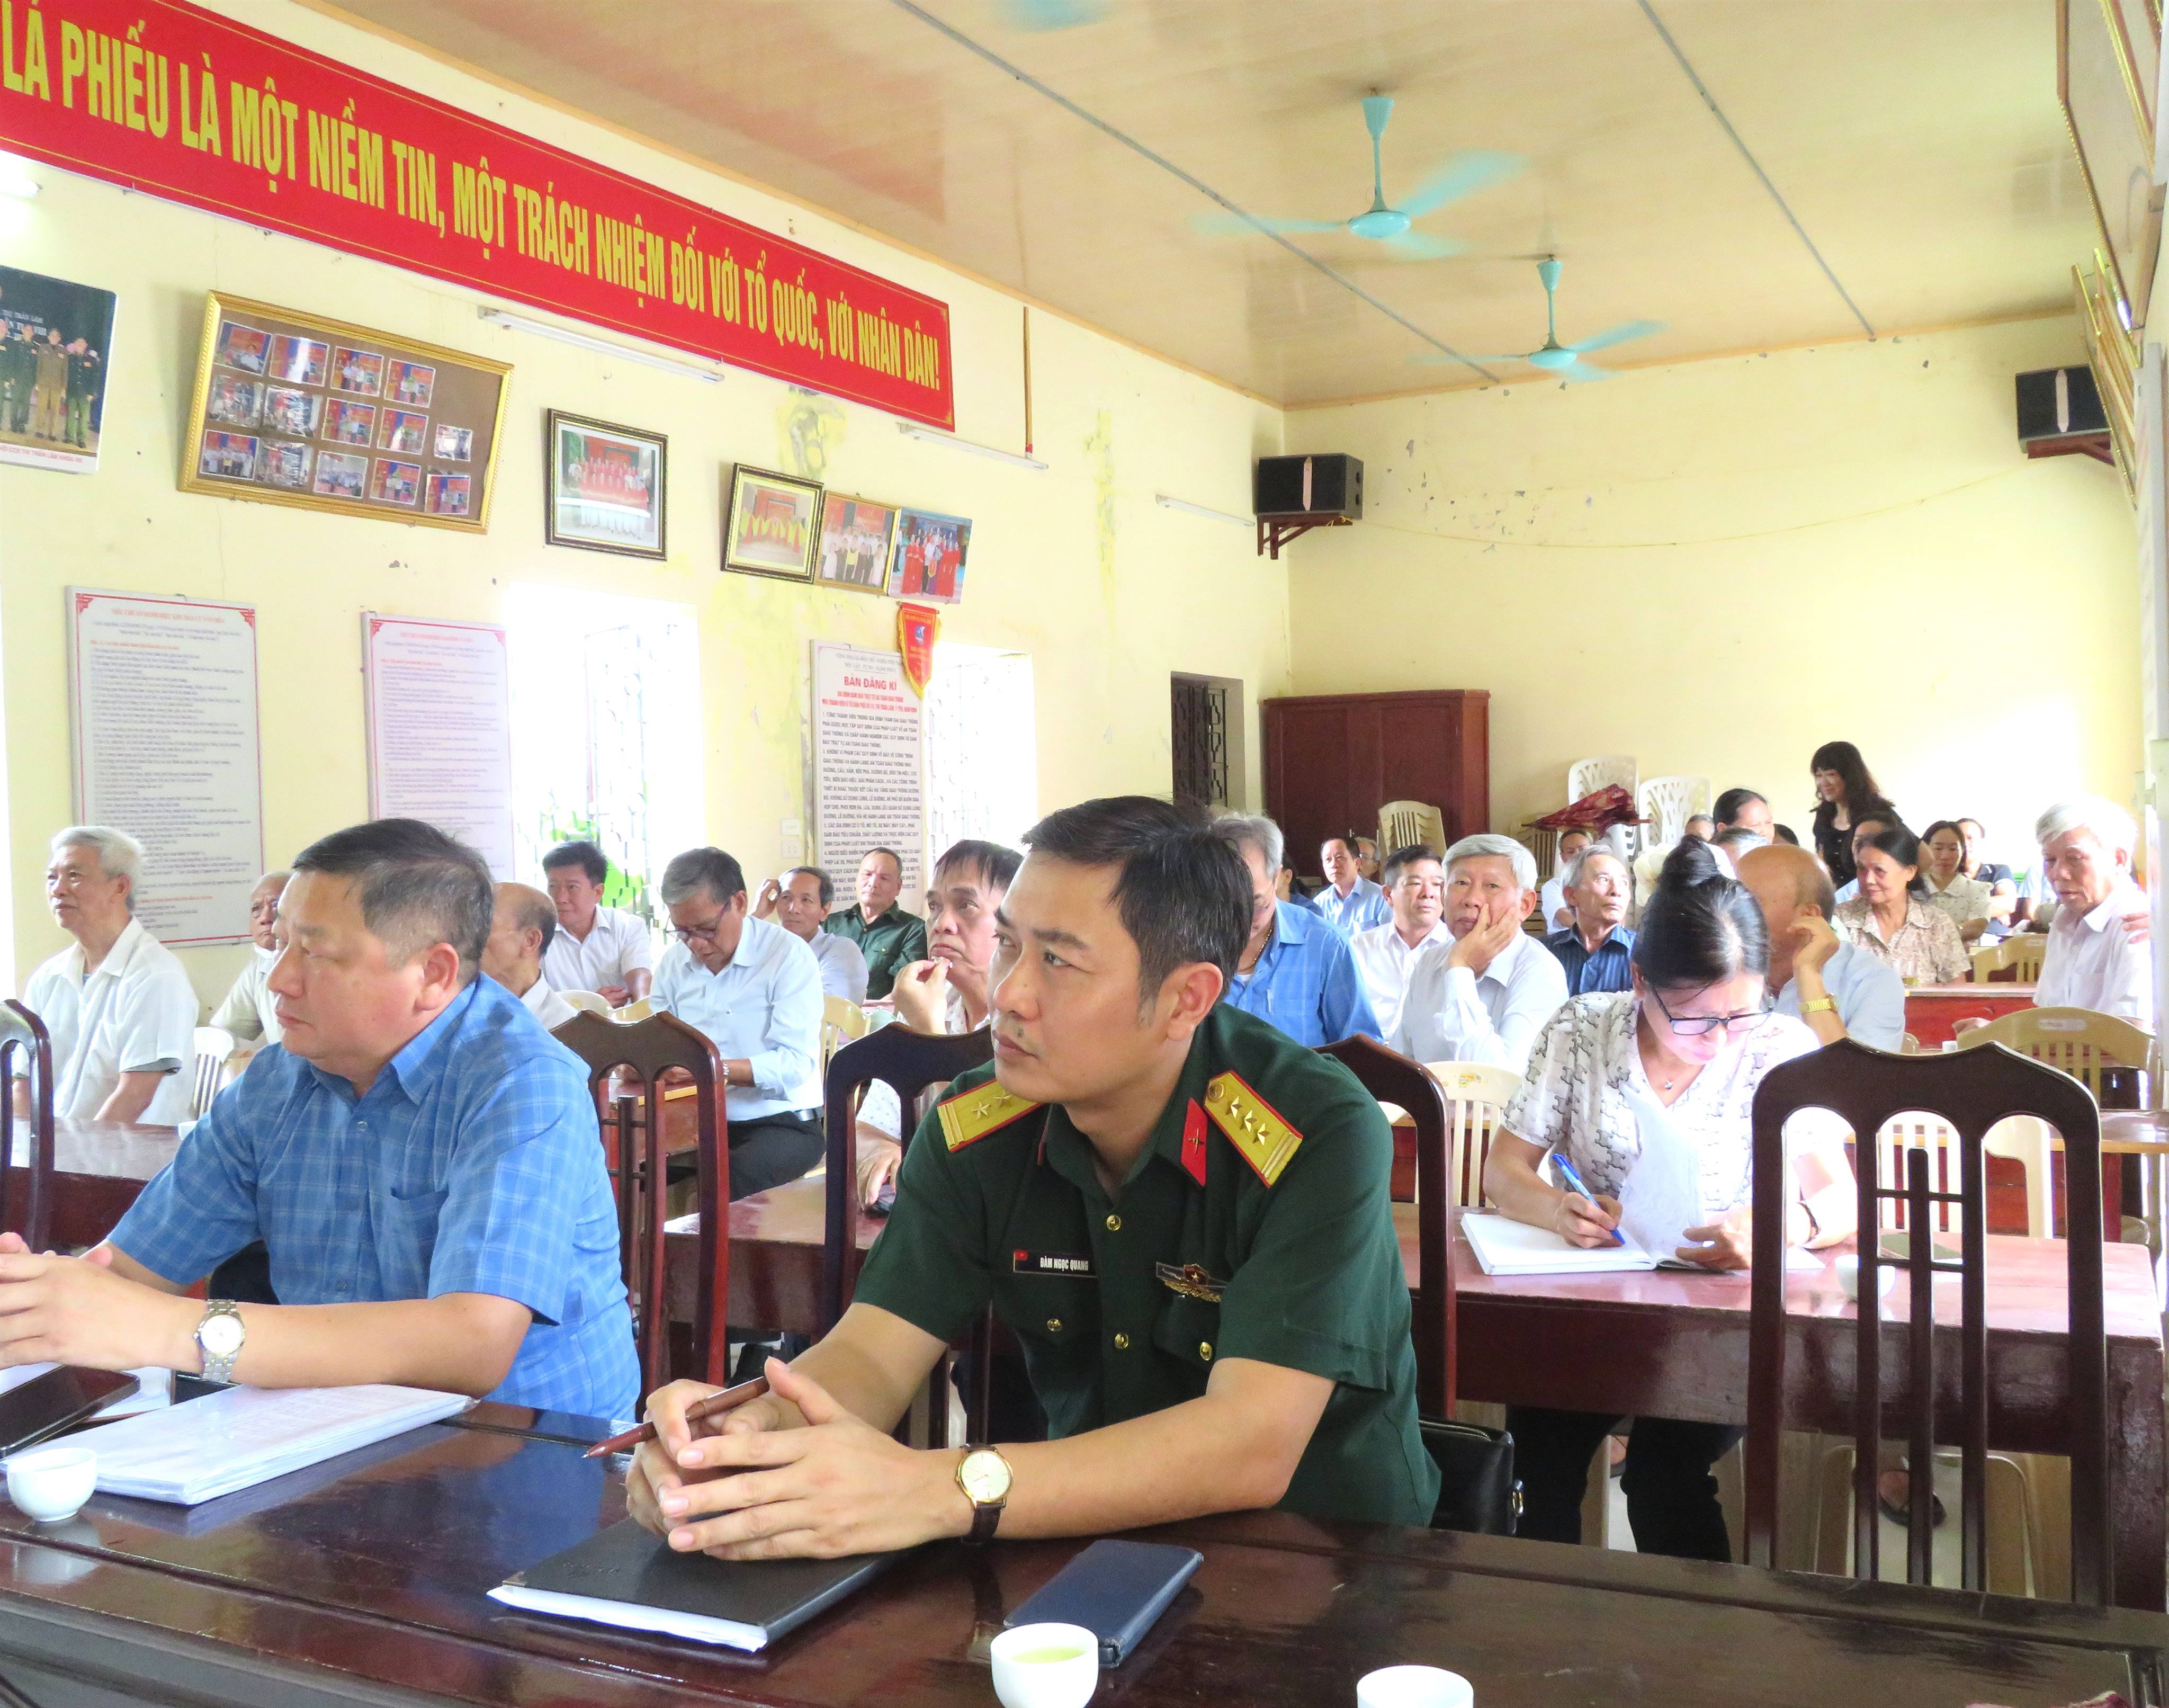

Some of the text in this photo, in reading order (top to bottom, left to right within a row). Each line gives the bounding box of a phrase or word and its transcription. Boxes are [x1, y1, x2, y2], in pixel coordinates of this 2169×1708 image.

[61, 19, 169, 138] PHIẾU
[180, 52, 222, 156] LÀ
[231, 76, 298, 192] MỘT
[308, 98, 385, 209] NIỀM
[392, 139, 445, 238] TIN,
[453, 156, 506, 259] MỘT
[513, 181, 590, 275] TRÁCH
[596, 213, 666, 307] NHIỆM
[671, 226, 705, 312] ĐỐI
[709, 247, 741, 325] VỚI
[745, 249, 768, 334] TỔ
[772, 268, 824, 360] QUỐC,
[827, 291, 854, 362] VỚI
[857, 307, 901, 378] NHÂN
[904, 320, 940, 390] DÂN!
[1054, 1258, 1069, 1271] NGỌC
[1070, 1259, 1089, 1271] QUANG
